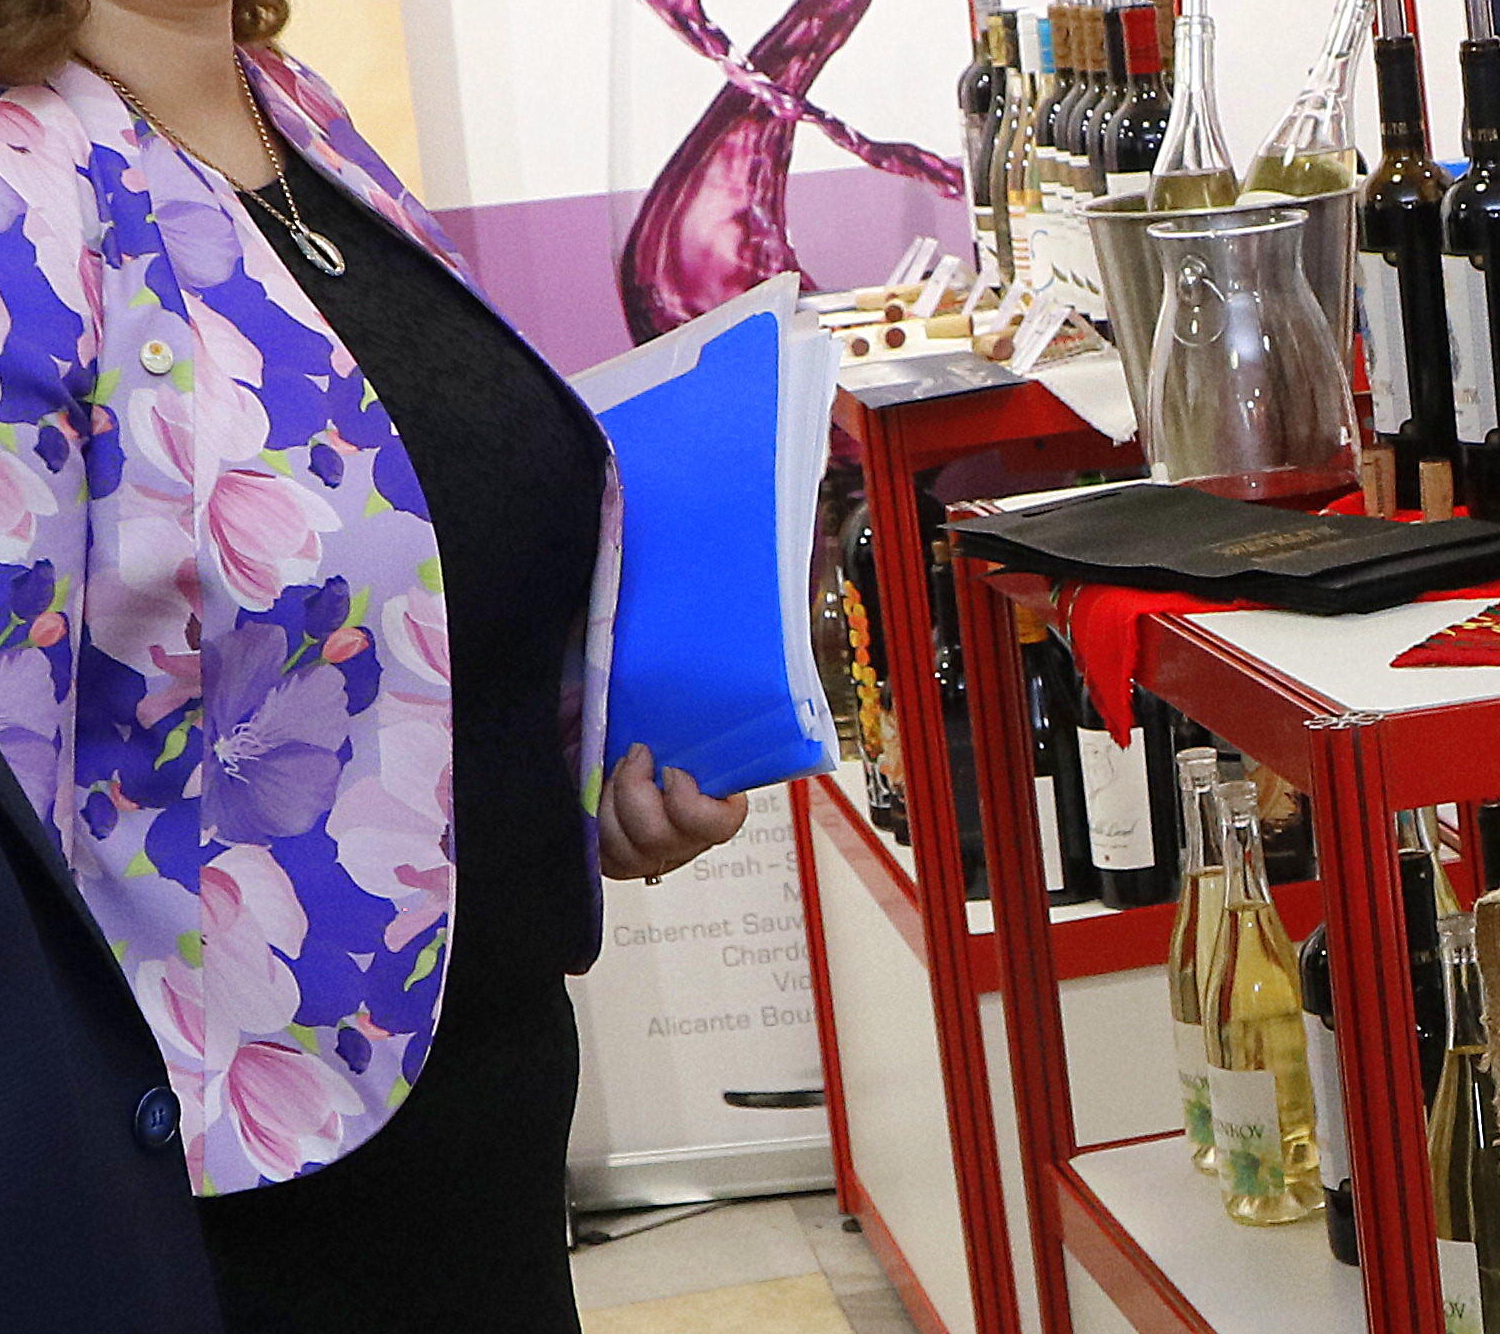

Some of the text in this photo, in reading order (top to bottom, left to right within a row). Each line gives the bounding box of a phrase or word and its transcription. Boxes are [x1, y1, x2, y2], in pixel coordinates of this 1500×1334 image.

[693, 854, 761, 882] Sirah
[613, 917, 731, 948] Cabernet
[647, 1010, 750, 1038] Alicante
